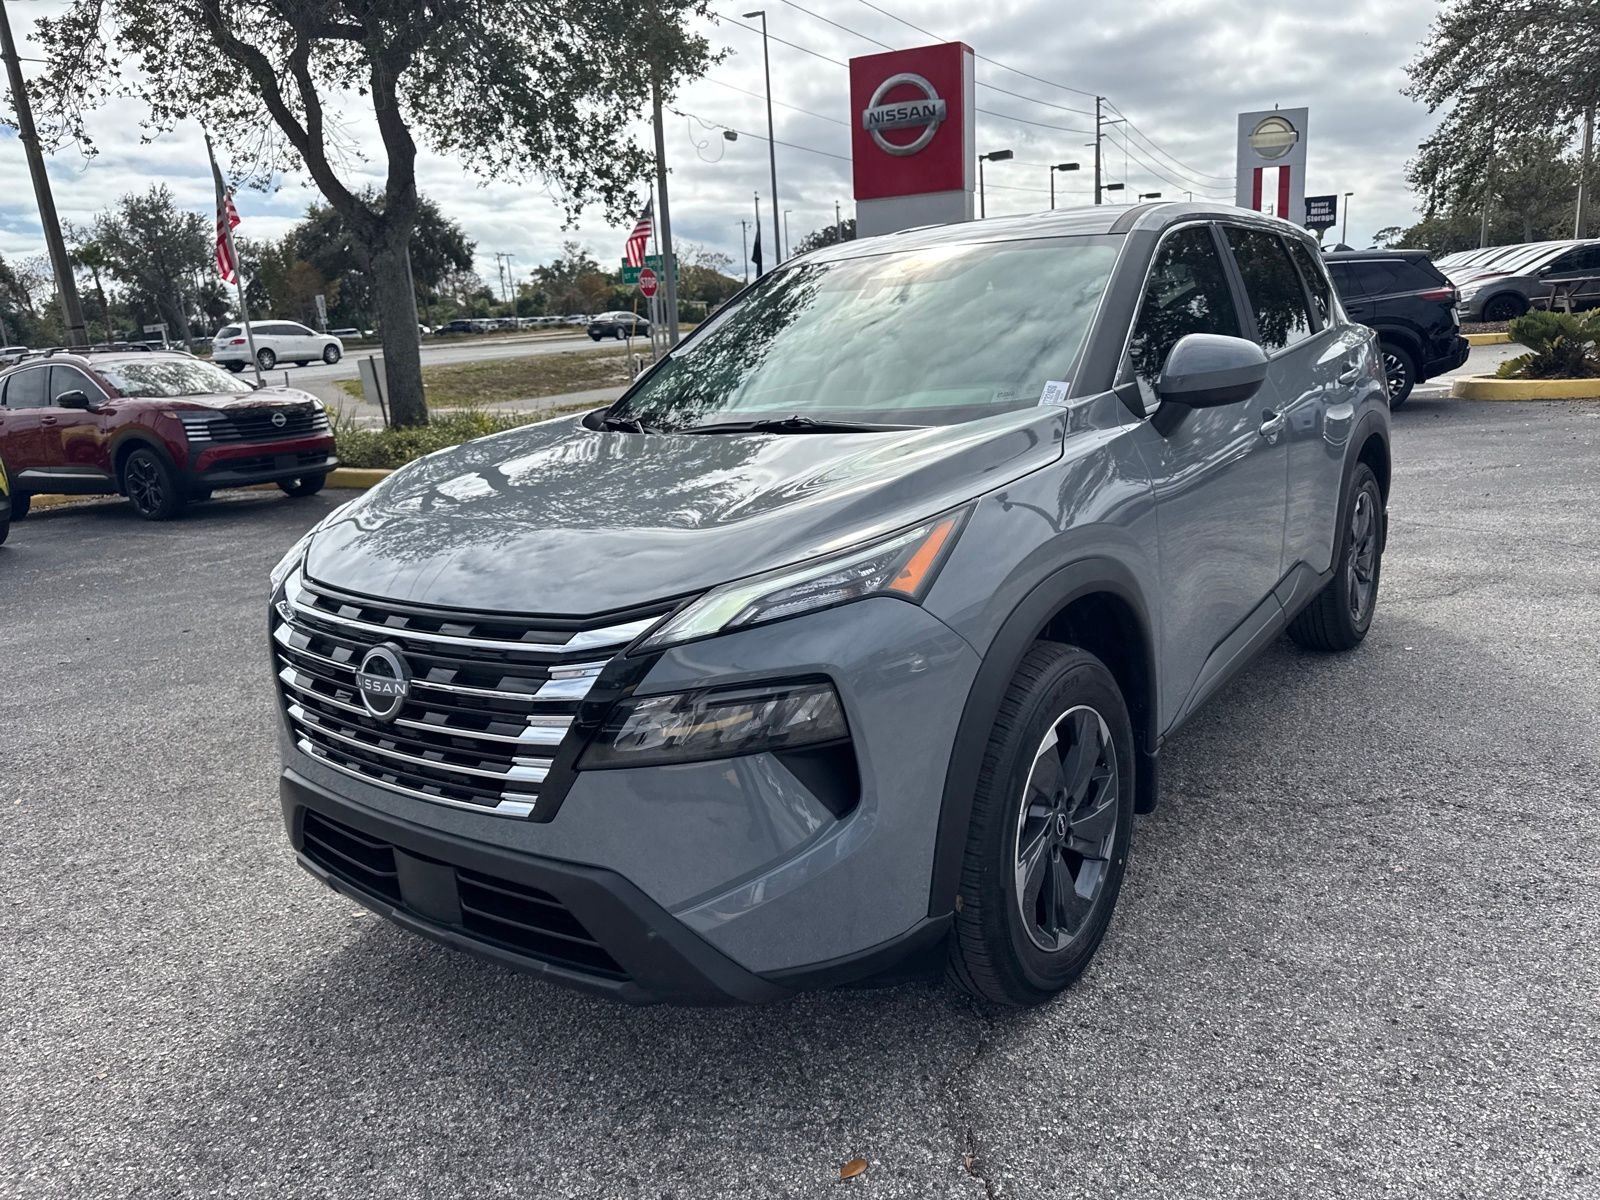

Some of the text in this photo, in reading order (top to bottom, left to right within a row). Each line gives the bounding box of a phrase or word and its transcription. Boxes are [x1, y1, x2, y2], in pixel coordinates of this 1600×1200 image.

[869, 104, 936, 124] NISSAN
[1307, 214, 1335, 222] Storage
[640, 277, 656, 289] STOP
